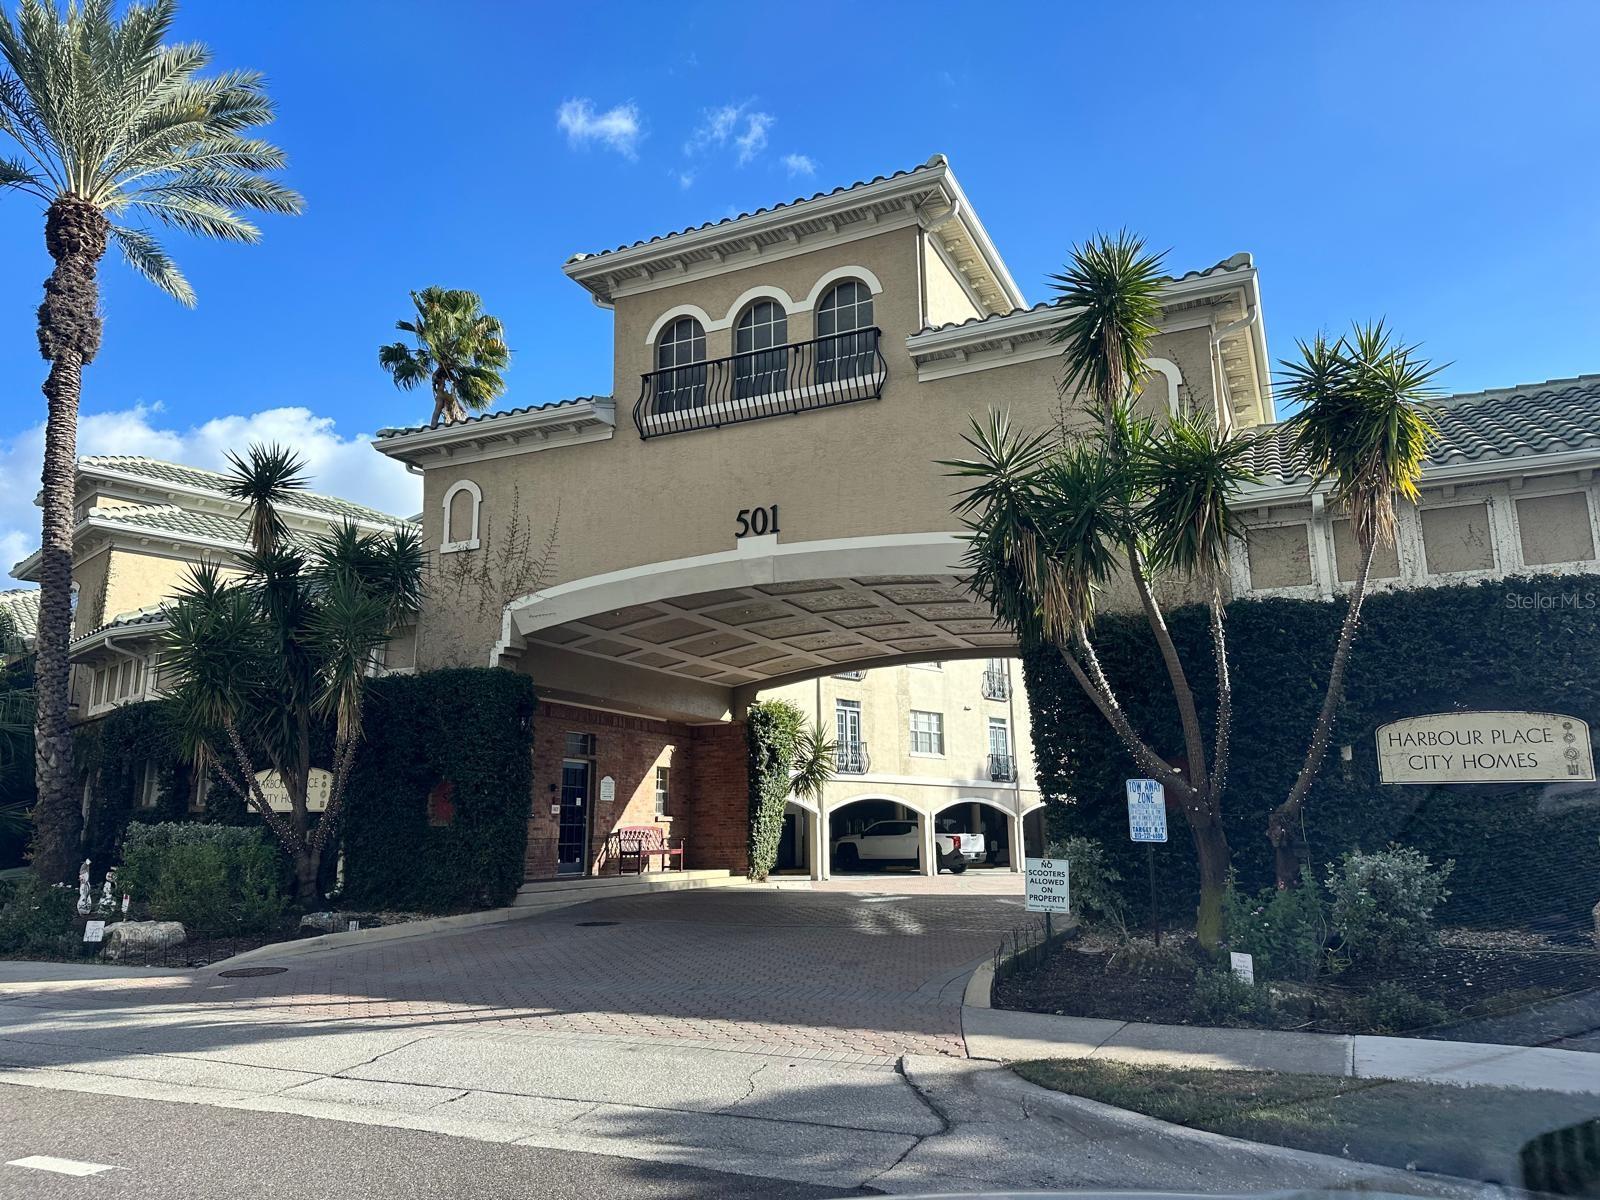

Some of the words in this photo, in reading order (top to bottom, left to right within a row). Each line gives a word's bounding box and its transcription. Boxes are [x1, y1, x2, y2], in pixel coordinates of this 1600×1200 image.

[734, 504, 780, 538] 501
[1388, 730, 1484, 747] HARBOUR
[1491, 728, 1554, 744] PLACE
[1408, 754, 1453, 770] CITY
[1462, 753, 1538, 769] HOMES
[1129, 781, 1142, 792] TOW
[1145, 781, 1161, 792] AWAY
[1137, 792, 1155, 803] ZONE
[1029, 894, 1066, 903] PROPERTY
